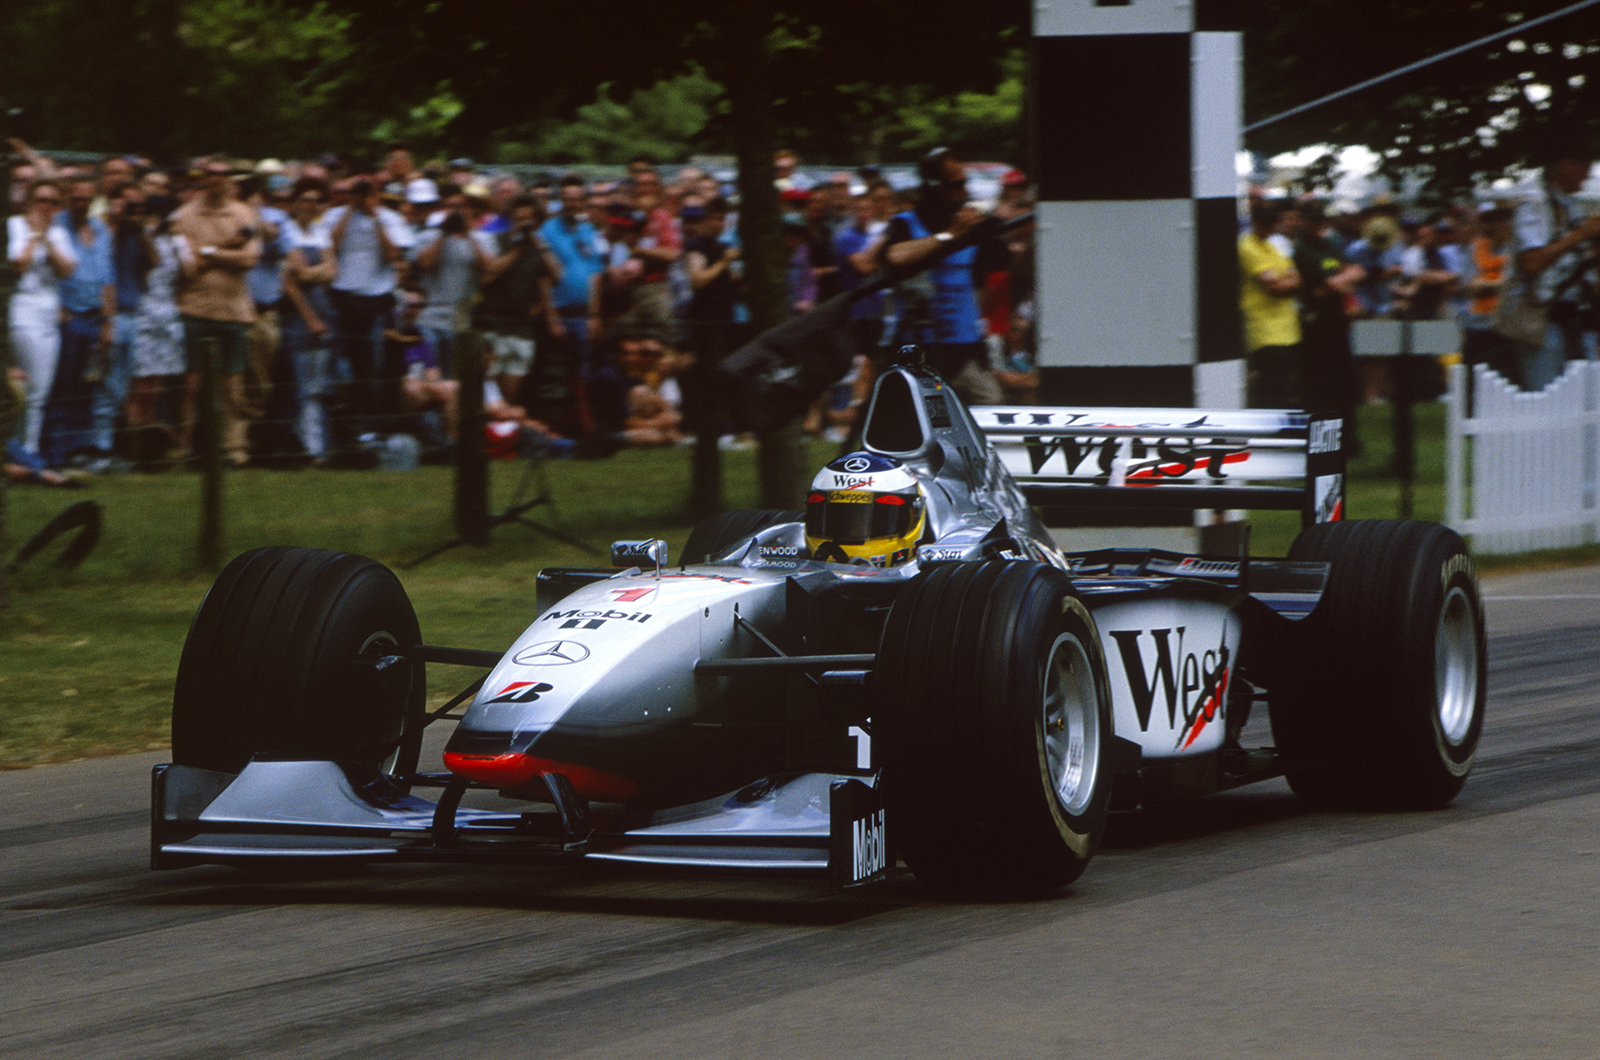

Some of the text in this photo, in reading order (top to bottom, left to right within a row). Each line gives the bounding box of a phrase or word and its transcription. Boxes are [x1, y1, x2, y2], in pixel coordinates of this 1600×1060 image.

[1022, 436, 1250, 486] West
[833, 474, 875, 490] West
[937, 549, 962, 560] Sun
[611, 588, 657, 602] 1
[541, 609, 653, 624] Mobil
[1109, 618, 1230, 750] West
[852, 808, 886, 881] Mobil
